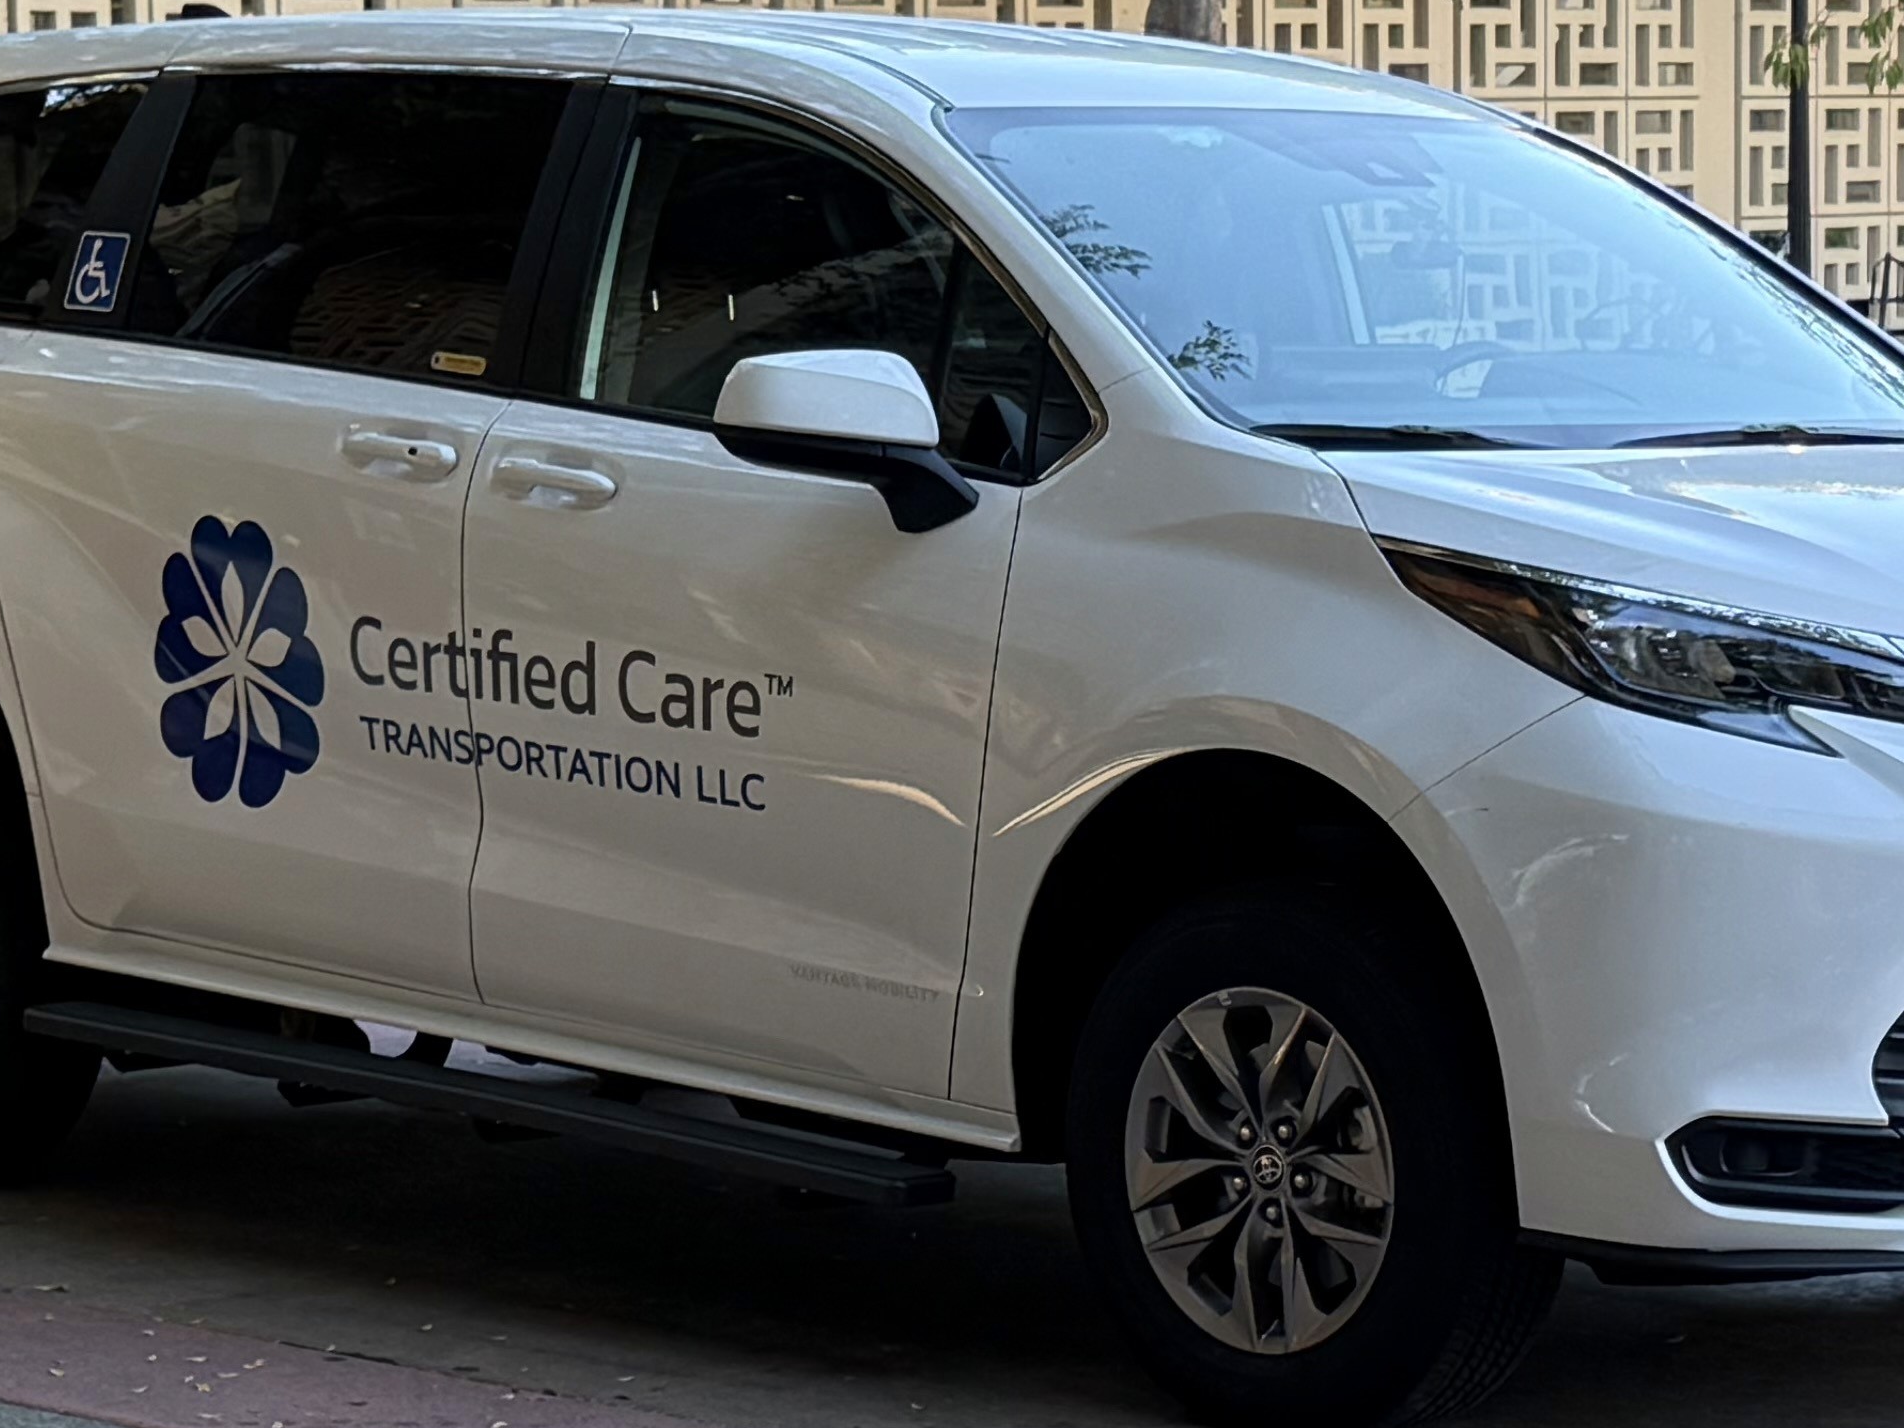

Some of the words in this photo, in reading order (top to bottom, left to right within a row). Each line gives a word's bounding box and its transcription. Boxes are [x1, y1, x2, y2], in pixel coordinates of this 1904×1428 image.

[349, 615, 597, 716] Certified
[359, 715, 682, 800] TRANSPORTATION
[696, 767, 767, 812] LLC
